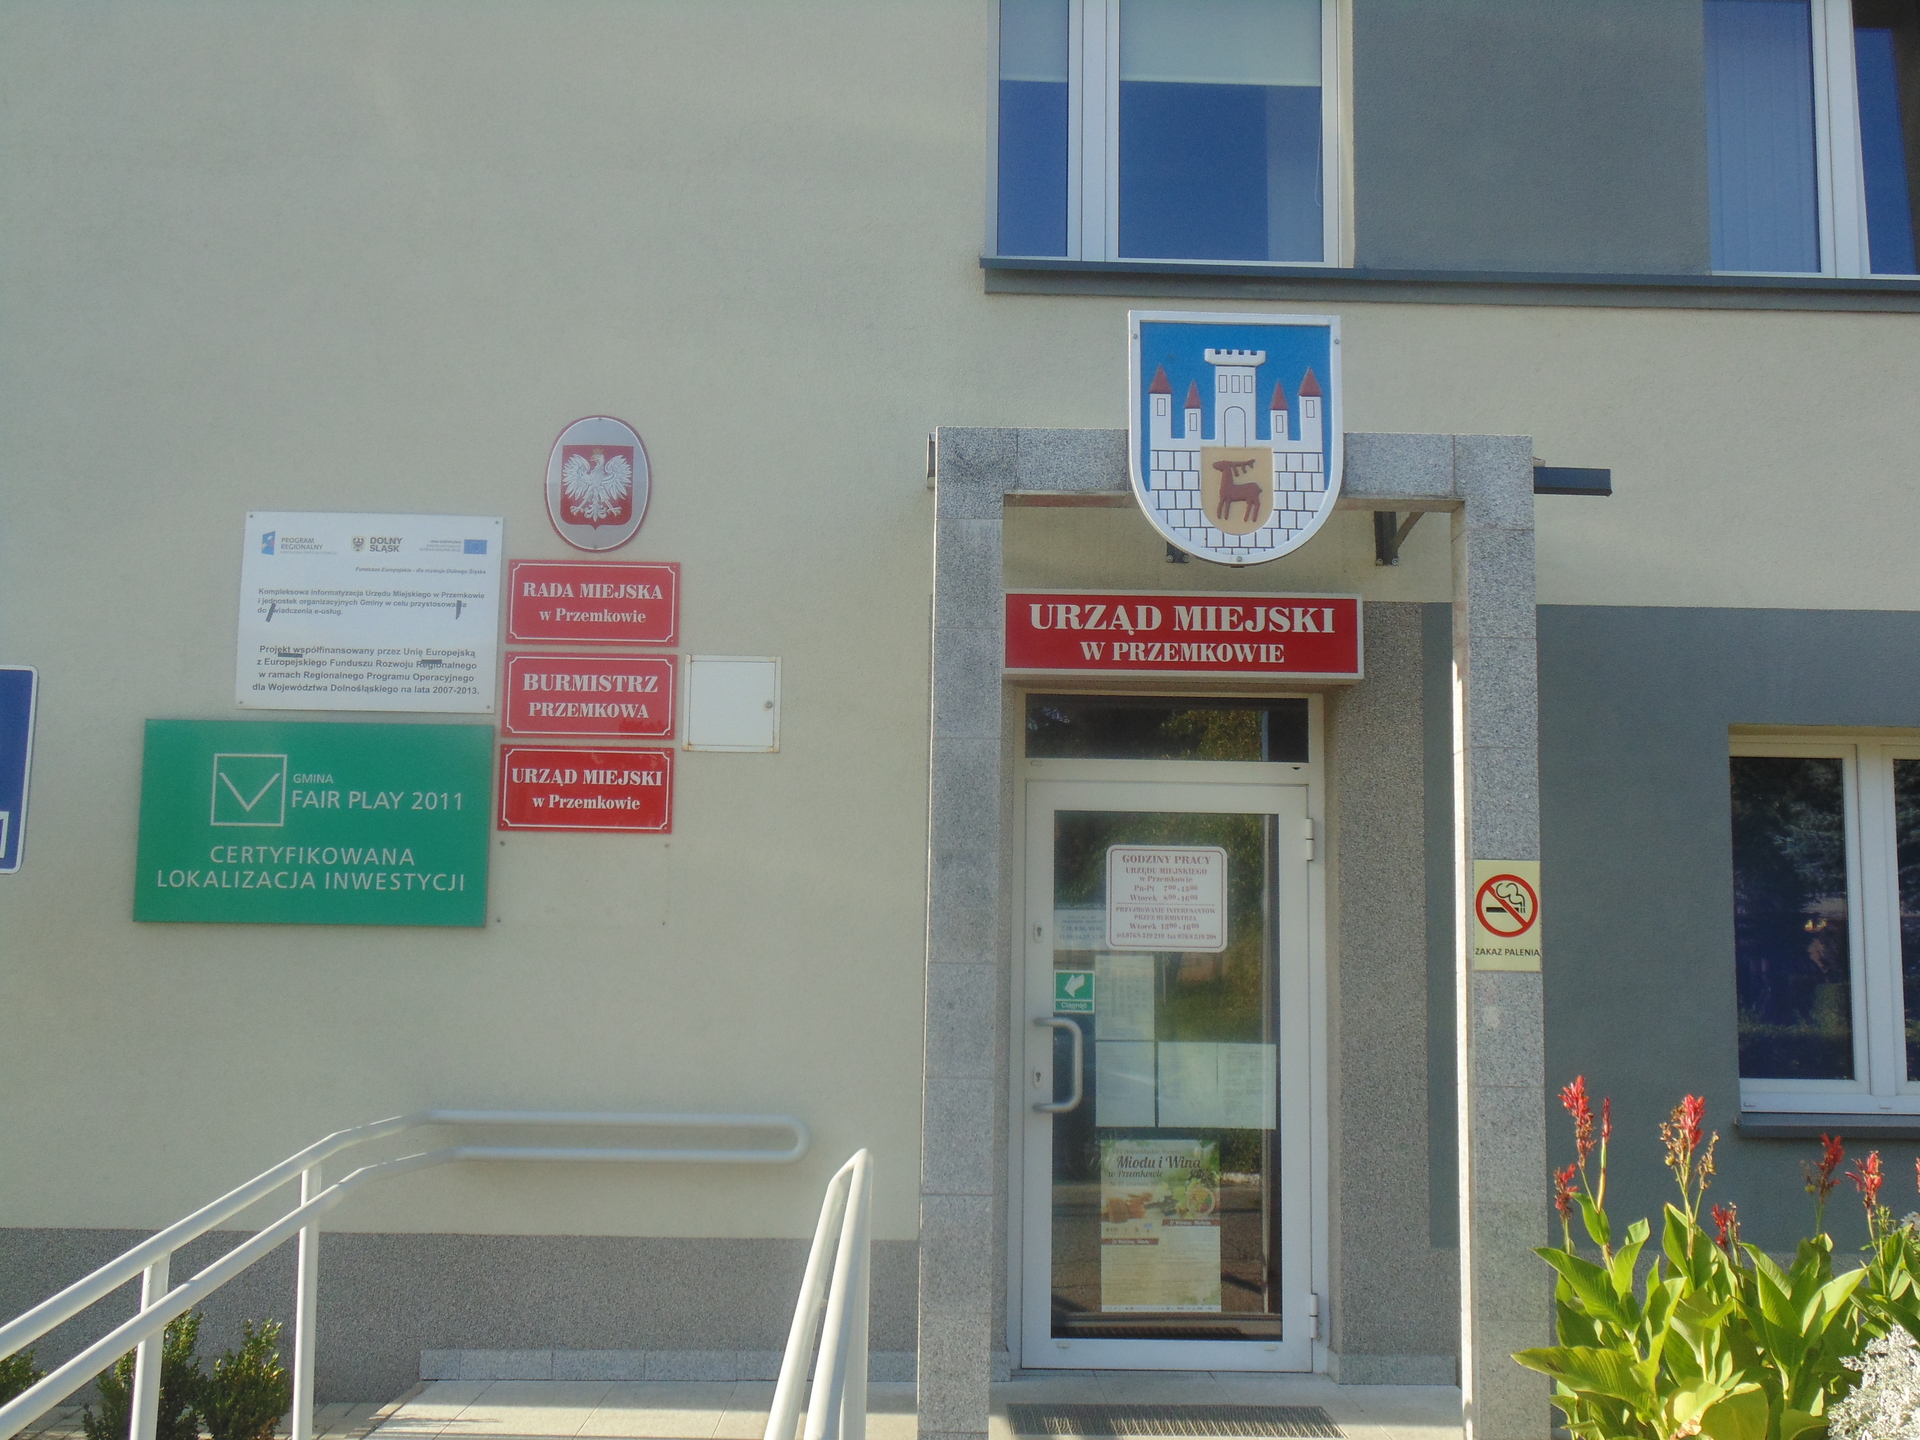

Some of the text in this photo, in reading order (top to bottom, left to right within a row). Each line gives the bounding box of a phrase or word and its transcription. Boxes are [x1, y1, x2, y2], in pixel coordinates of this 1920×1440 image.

[258, 588, 309, 596] Kompleksowa
[311, 589, 364, 598] informatyzacja
[365, 590, 391, 598] Urzędu
[392, 590, 431, 599] Miejskiego
[522, 582, 663, 600] RADA MIEJSKA
[539, 608, 646, 624] w Przemkowie
[1029, 604, 1336, 636] URZĄD MIEJSKI
[259, 645, 291, 654] Projekt
[293, 646, 374, 656] współfinansowany
[403, 648, 423, 657] Unię
[426, 648, 476, 658] Europejską
[1079, 641, 1285, 663] W PRZEMKOWIE
[264, 658, 327, 668] Europejskiego
[330, 659, 373, 667] Funduszu
[376, 660, 414, 669] Rozwoju
[416, 661, 477, 671] Regionalnego
[303, 671, 364, 681] Regionalnego
[366, 672, 410, 681] Programu
[412, 673, 475, 683] Operacyjnego
[522, 674, 658, 693] BURMISTRZ
[268, 683, 328, 693] Województwa
[330, 684, 398, 694] Dolnośląskiego
[432, 686, 480, 695] 2007-2013.
[528, 702, 649, 718] PRZEMKOWA
[292, 773, 334, 784] GMINA
[512, 768, 662, 786] URZĄD MIEJSKI
[291, 790, 464, 810] FAIR PLAY 2011
[532, 794, 640, 810] w Przemkowie
[210, 846, 415, 866] CERTYFIKOWANA
[1122, 854, 1211, 864] GODZINY PRACY
[1125, 867, 1158, 876] URZĘDU
[157, 870, 465, 891] LOKALIZACJA INWESTYCJI
[1505, 948, 1540, 956] PALENIA
[1117, 1156, 1201, 1168] Miodu i Wina
[1118, 1170, 1163, 1178] Przemkowie
